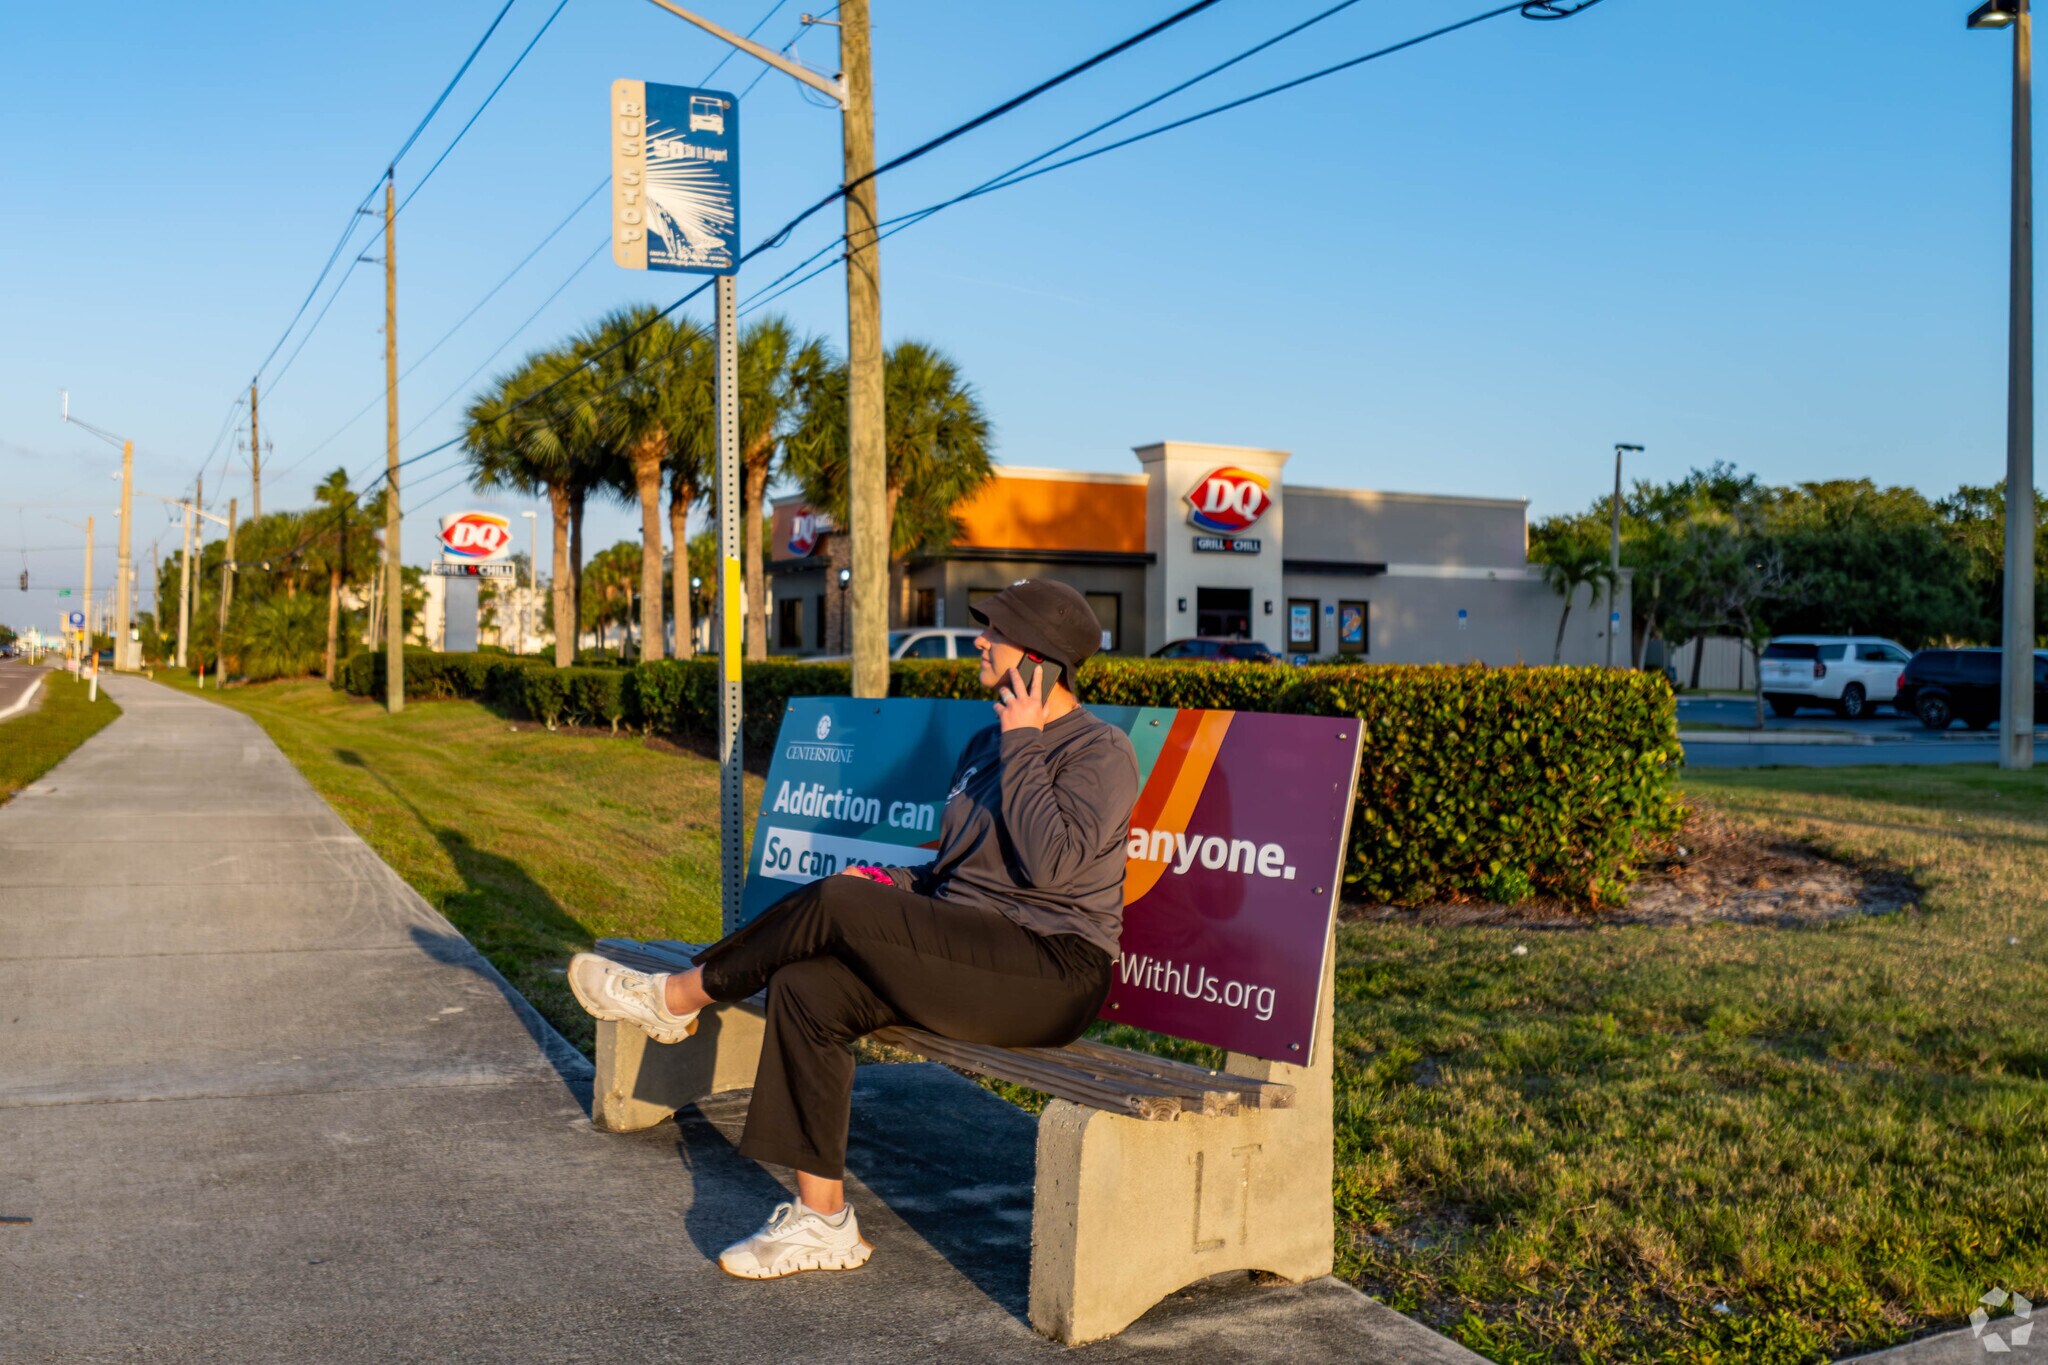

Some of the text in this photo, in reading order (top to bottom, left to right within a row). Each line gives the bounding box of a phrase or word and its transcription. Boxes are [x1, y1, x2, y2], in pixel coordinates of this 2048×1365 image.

[620, 101, 642, 244] BUS STOP
[1202, 479, 1263, 521] DQ
[452, 523, 501, 551] DQ
[793, 514, 816, 543] DQ
[1198, 540, 1225, 550] GRILL
[1233, 541, 1259, 552] CHILL
[437, 564, 467, 575] GRILL
[478, 565, 513, 576] CHILL
[785, 746, 854, 763] CENTERSTONE
[773, 780, 935, 831] Addiction can
[764, 836, 792, 871] So
[799, 849, 837, 877] can
[1127, 827, 1297, 880] anyone.
